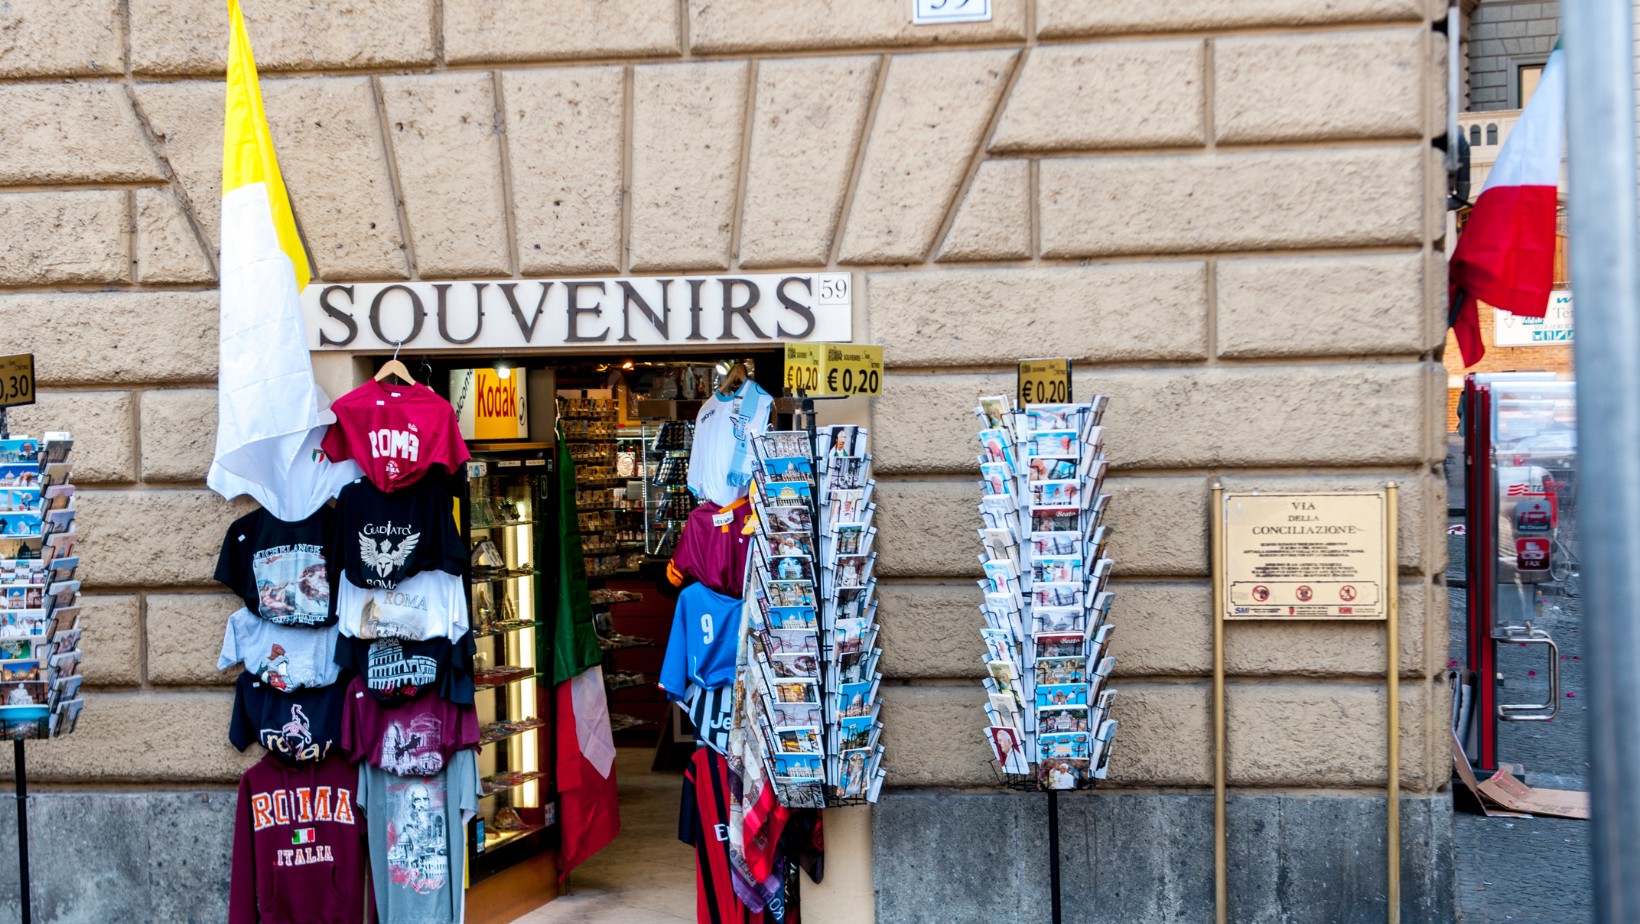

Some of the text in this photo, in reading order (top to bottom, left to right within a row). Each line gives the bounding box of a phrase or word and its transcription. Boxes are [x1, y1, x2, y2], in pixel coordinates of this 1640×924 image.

[821, 278, 848, 300] 59
[319, 276, 816, 347] SOUVENIRS
[786, 365, 818, 391] € 0,20
[827, 368, 879, 395] € 0,20
[477, 373, 517, 418] Kodak
[1022, 380, 1066, 404] € 0,20
[368, 428, 420, 463] ROMA
[1291, 502, 1316, 510] VIA
[1252, 525, 1358, 535] CONCILIAZIONE
[383, 592, 428, 612] ROMA
[701, 613, 714, 645] 9
[251, 786, 355, 832] ROMA
[277, 845, 334, 867] ITALIA
